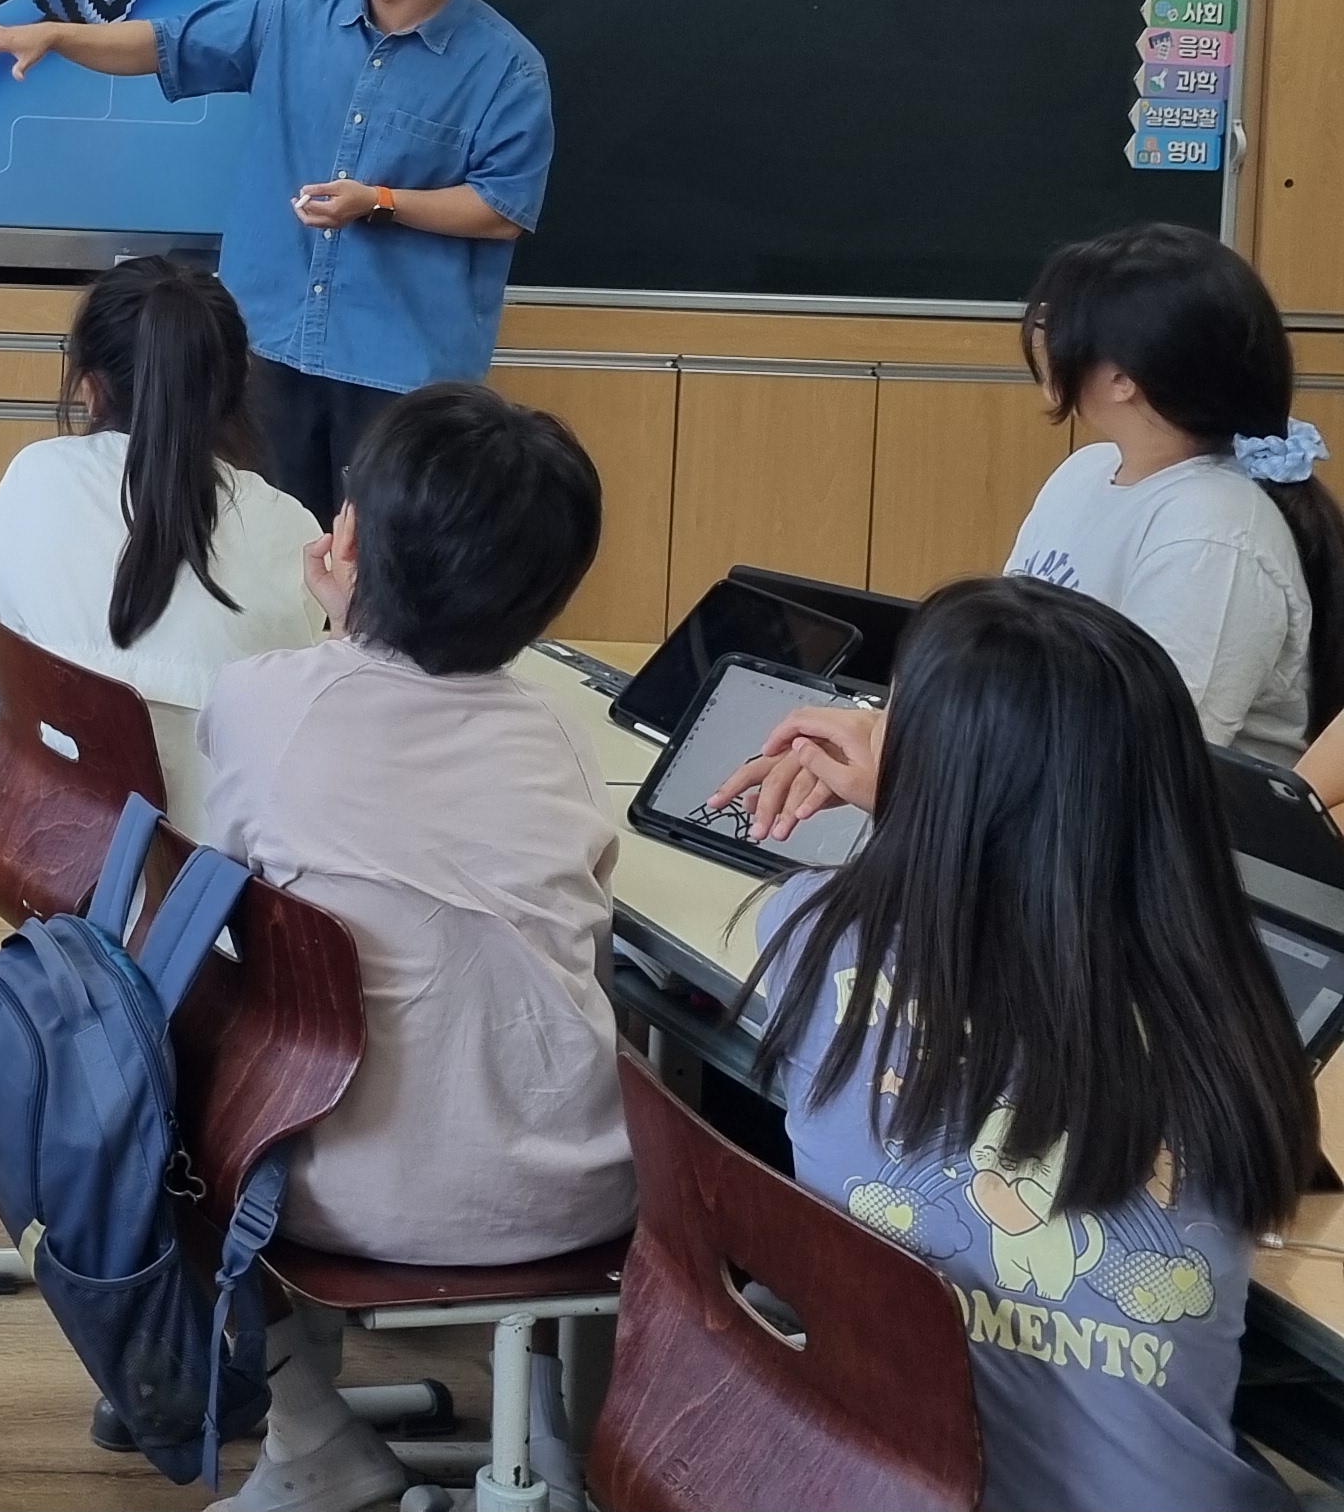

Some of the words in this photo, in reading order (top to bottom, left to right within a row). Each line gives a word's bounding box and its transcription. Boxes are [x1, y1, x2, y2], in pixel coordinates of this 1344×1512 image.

[1182, 1, 1224, 25] 사회
[1178, 35, 1221, 59] 음악
[1176, 70, 1218, 94] 과학
[1145, 106, 1218, 128] 실험관찰
[1167, 141, 1207, 163] 영어
[952, 1284, 1174, 1387] MENTS!
